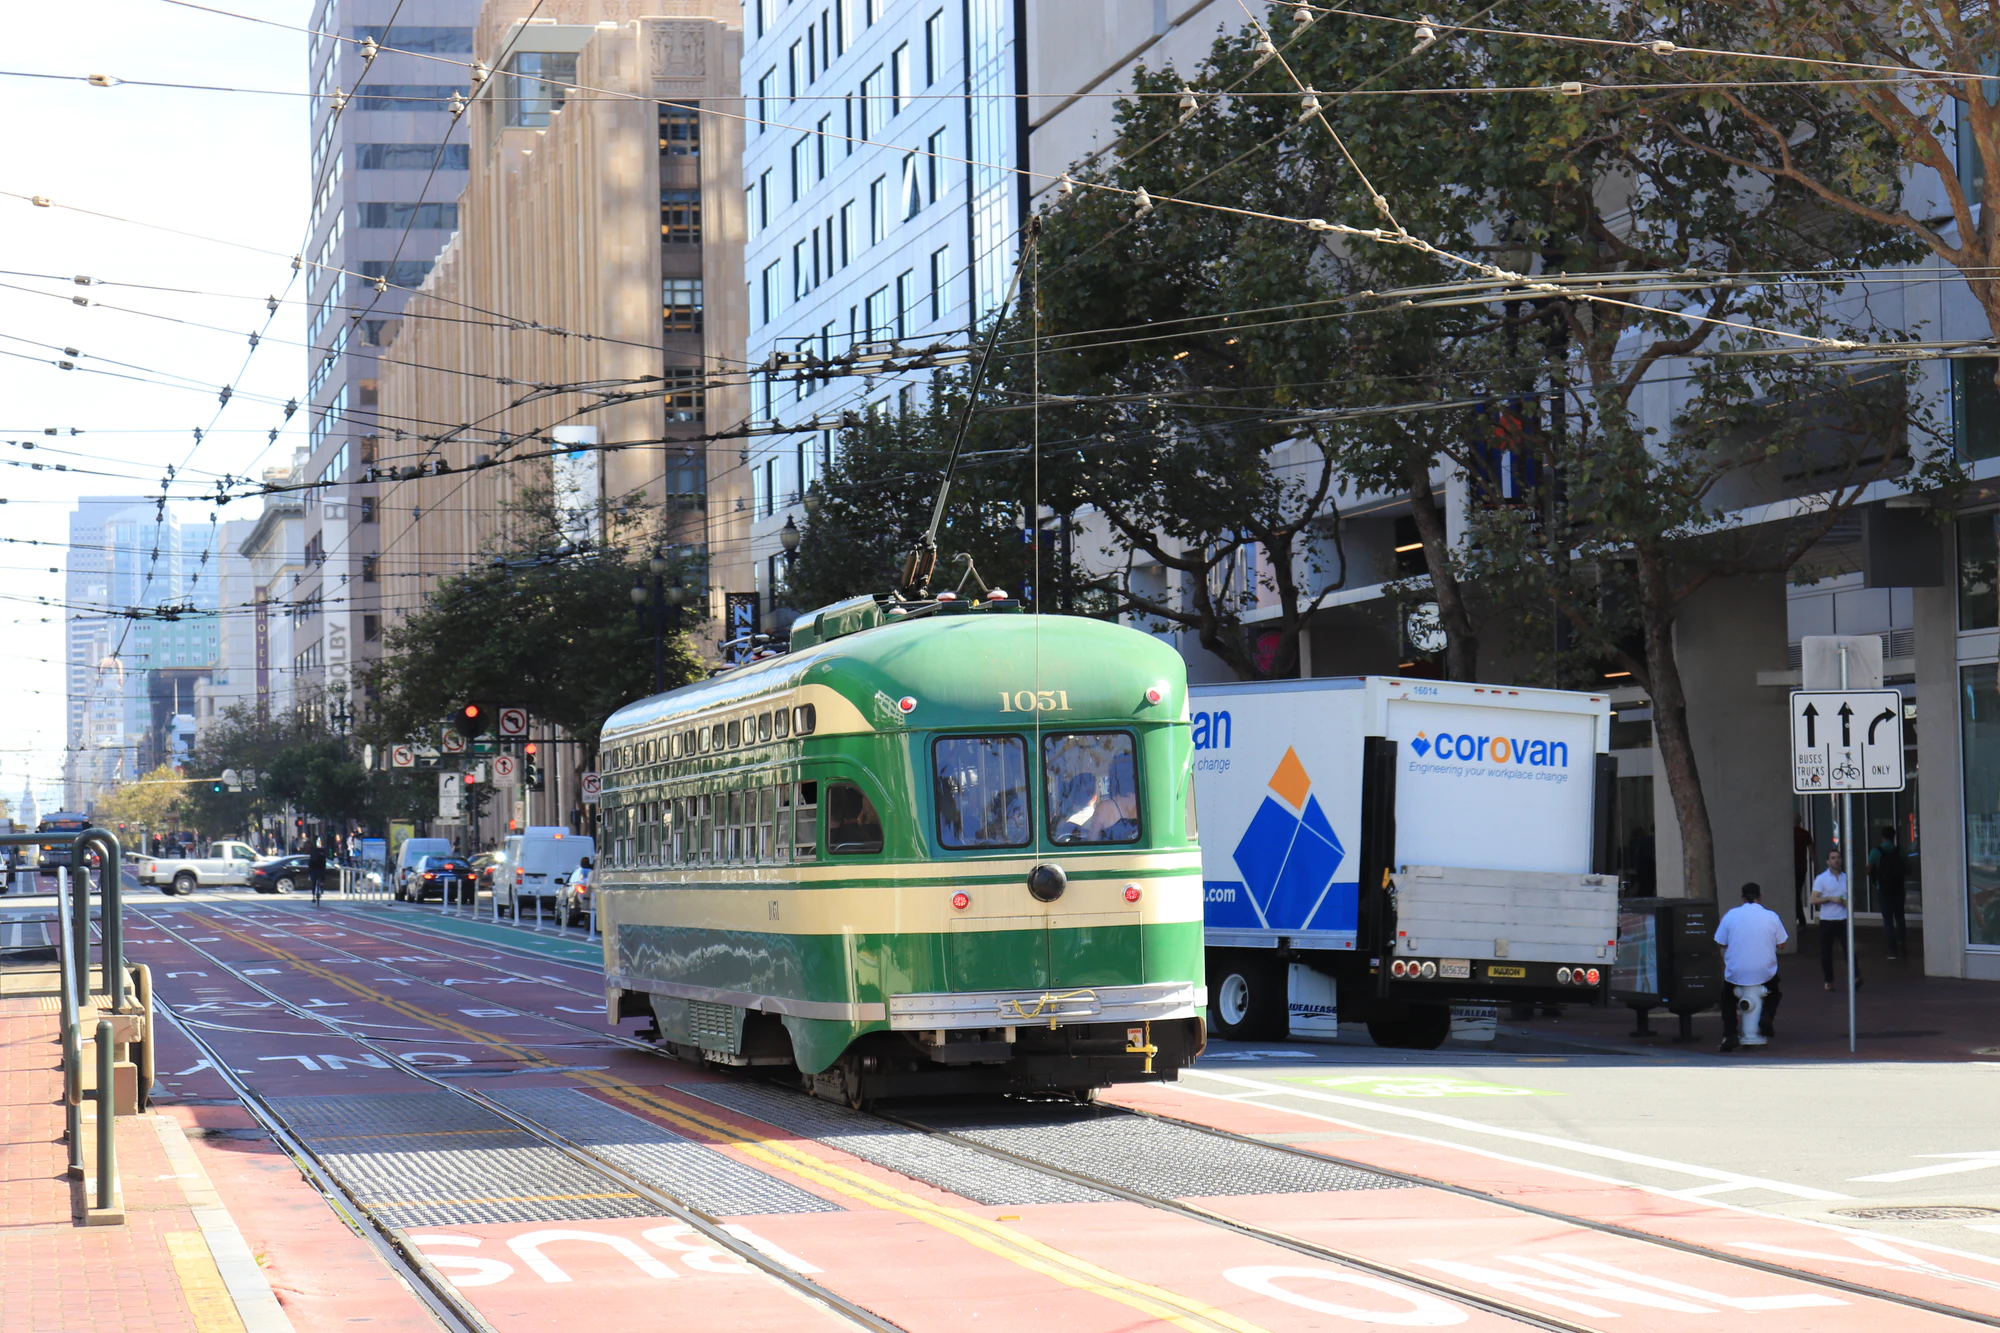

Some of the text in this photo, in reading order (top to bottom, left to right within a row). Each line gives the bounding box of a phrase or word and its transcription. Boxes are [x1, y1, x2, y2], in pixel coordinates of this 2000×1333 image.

[258, 612, 267, 670] HOTEL
[1413, 686, 1438, 696] 16014
[998, 690, 1073, 713] 1051
[1189, 710, 1232, 751] an
[1434, 732, 1569, 768] corovan
[1197, 757, 1231, 774] change
[1798, 754, 1823, 764] BUSES
[1408, 761, 1569, 784] Engineering your workplace change
[1797, 766, 1825, 776] TRUCKS
[1871, 765, 1891, 775] ONLY
[1202, 888, 1236, 903] .com
[1493, 967, 1520, 977] MAXON
[410, 1222, 826, 1288] BUS
